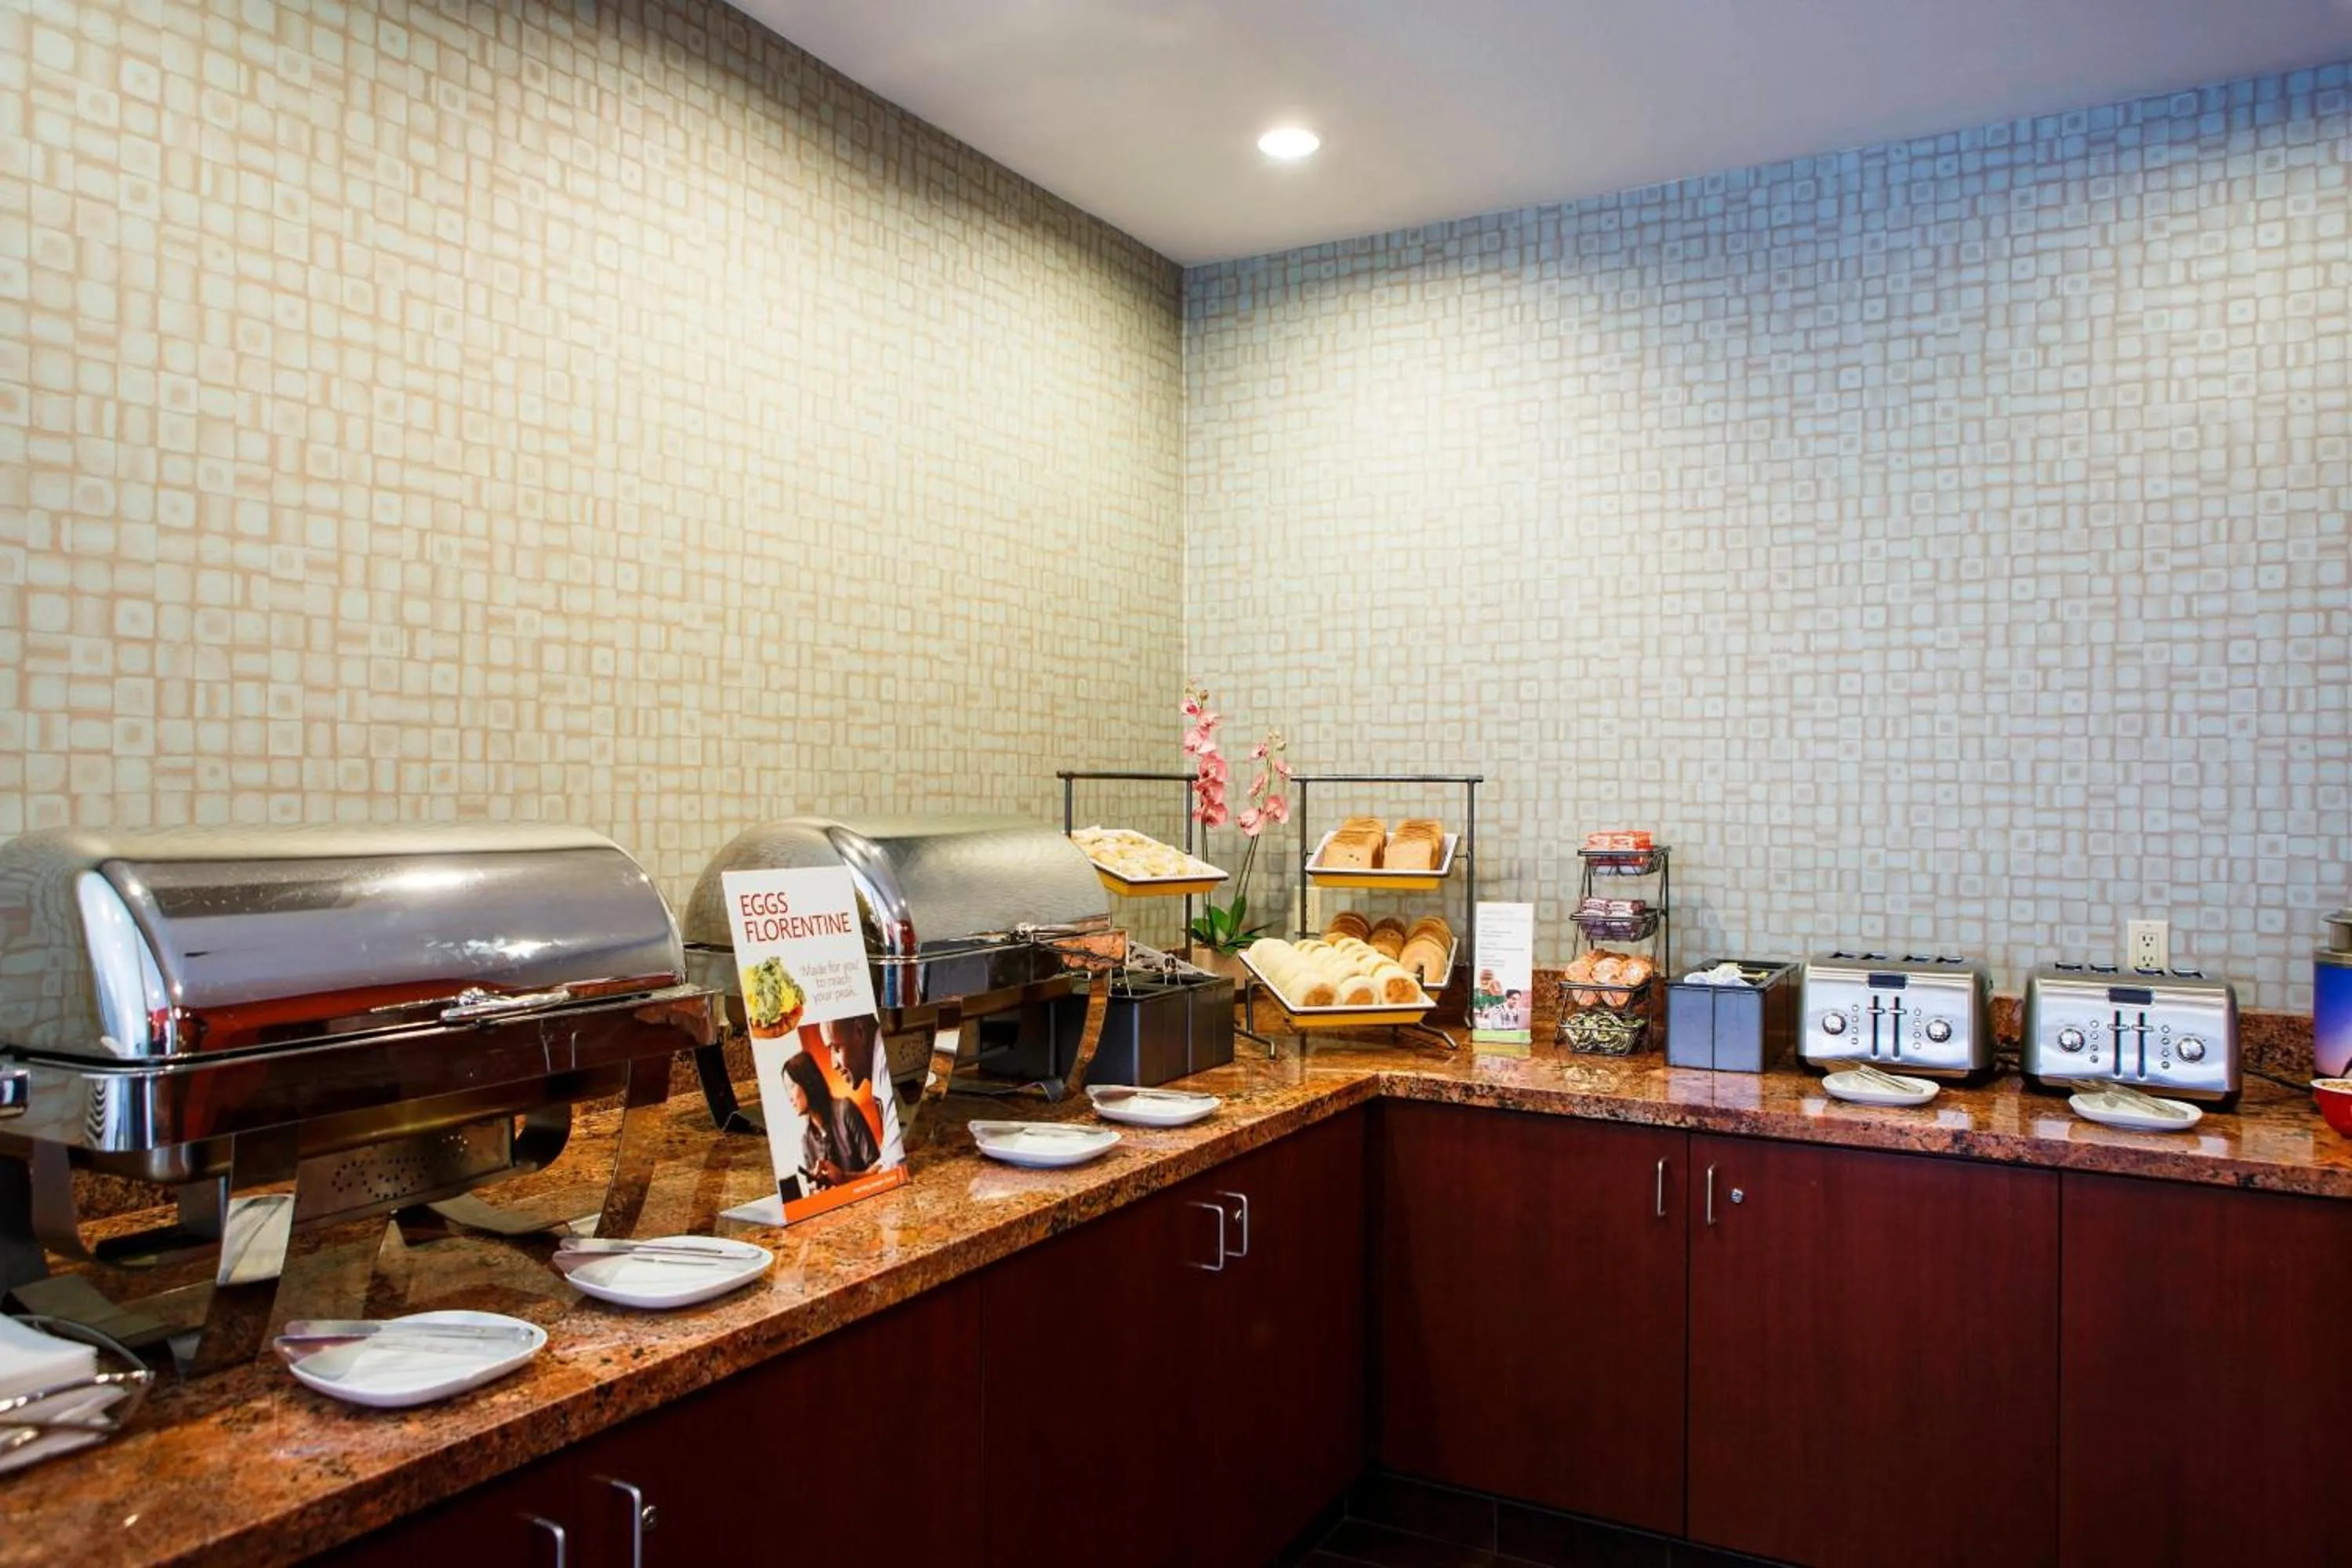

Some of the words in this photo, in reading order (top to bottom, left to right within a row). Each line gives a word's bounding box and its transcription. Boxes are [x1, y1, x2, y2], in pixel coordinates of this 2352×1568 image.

[739, 891, 788, 916] EGGS
[745, 912, 851, 942] FLORENTINE
[802, 963, 827, 977] Made
[828, 960, 840, 974] for
[816, 978, 826, 988] to
[812, 991, 832, 1006] your
